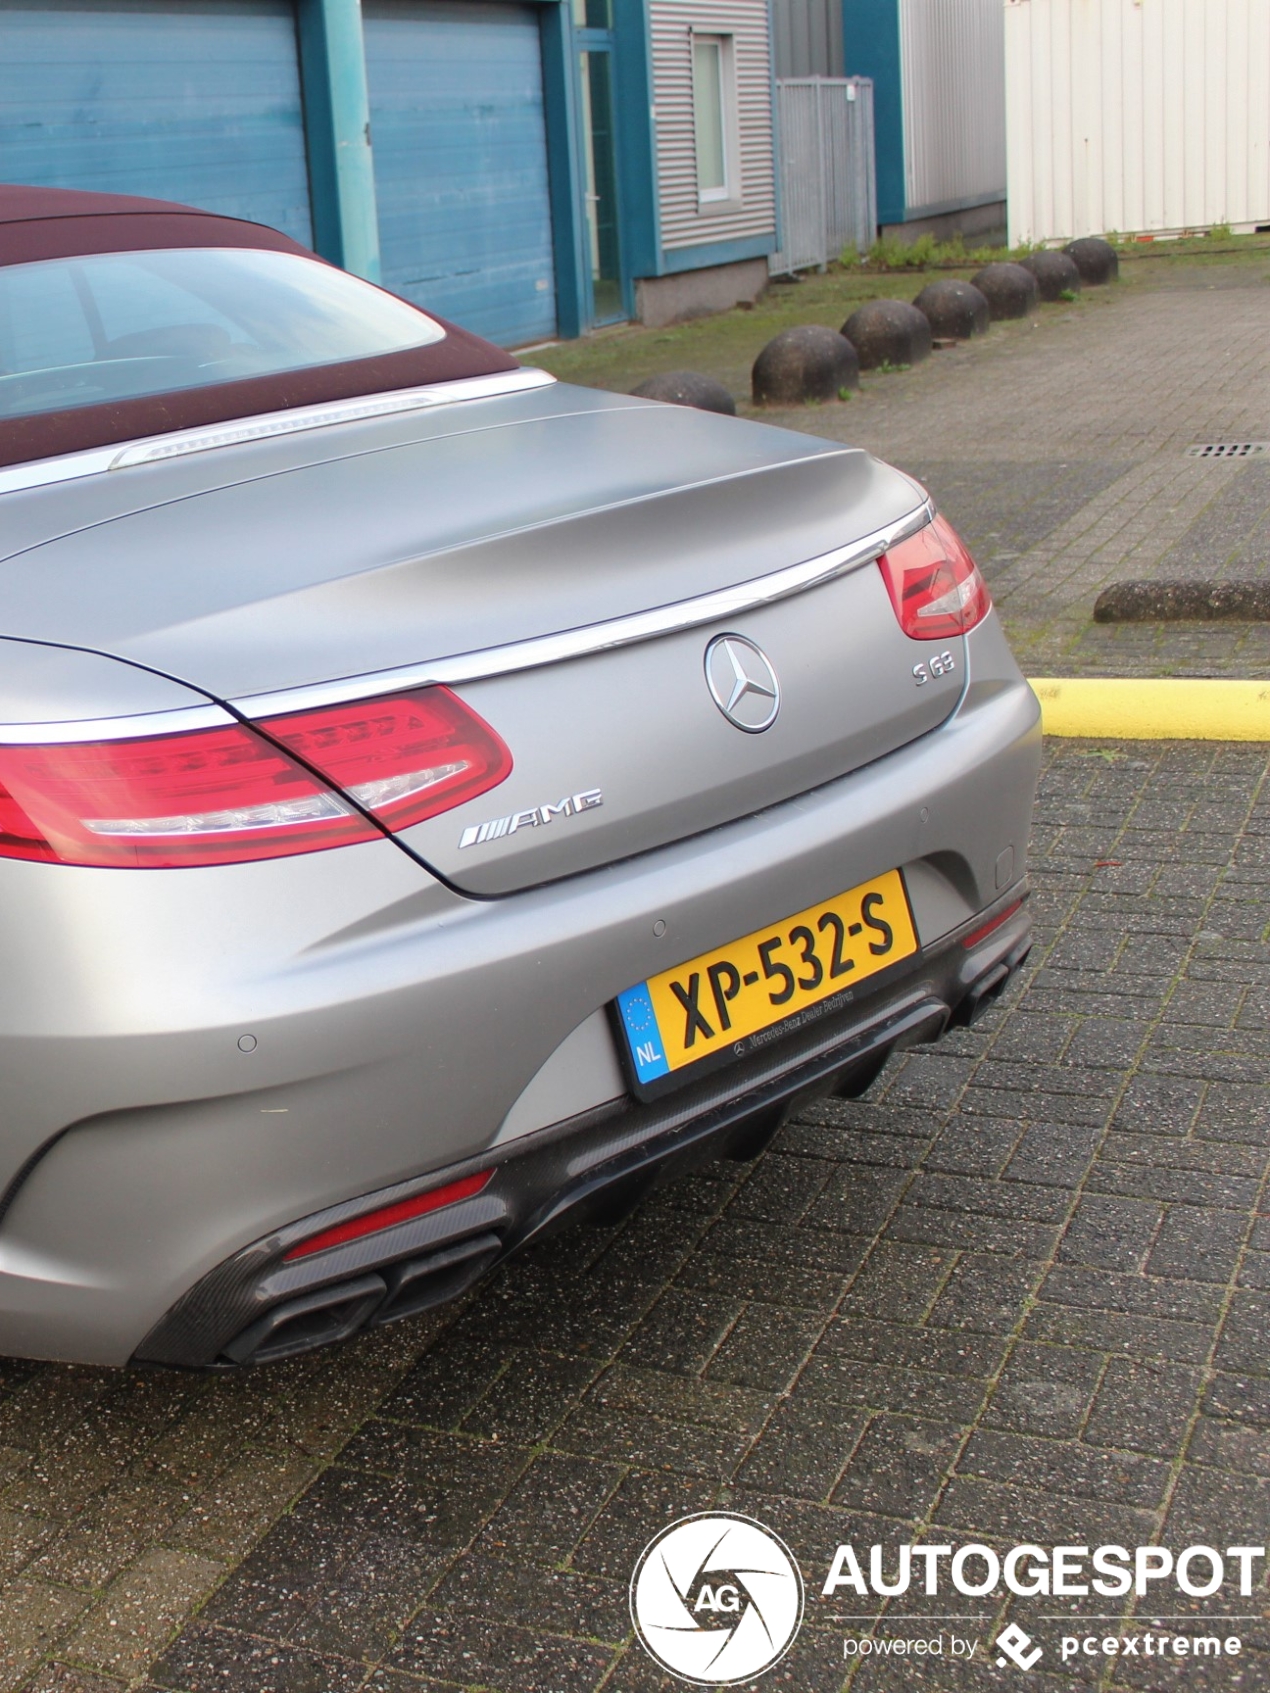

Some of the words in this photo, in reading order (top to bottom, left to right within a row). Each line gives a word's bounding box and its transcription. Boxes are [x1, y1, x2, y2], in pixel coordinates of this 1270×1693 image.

[912, 663, 928, 686] S
[929, 651, 956, 679] 63
[669, 893, 893, 1049] XP-532-S
[636, 1041, 661, 1067] NL
